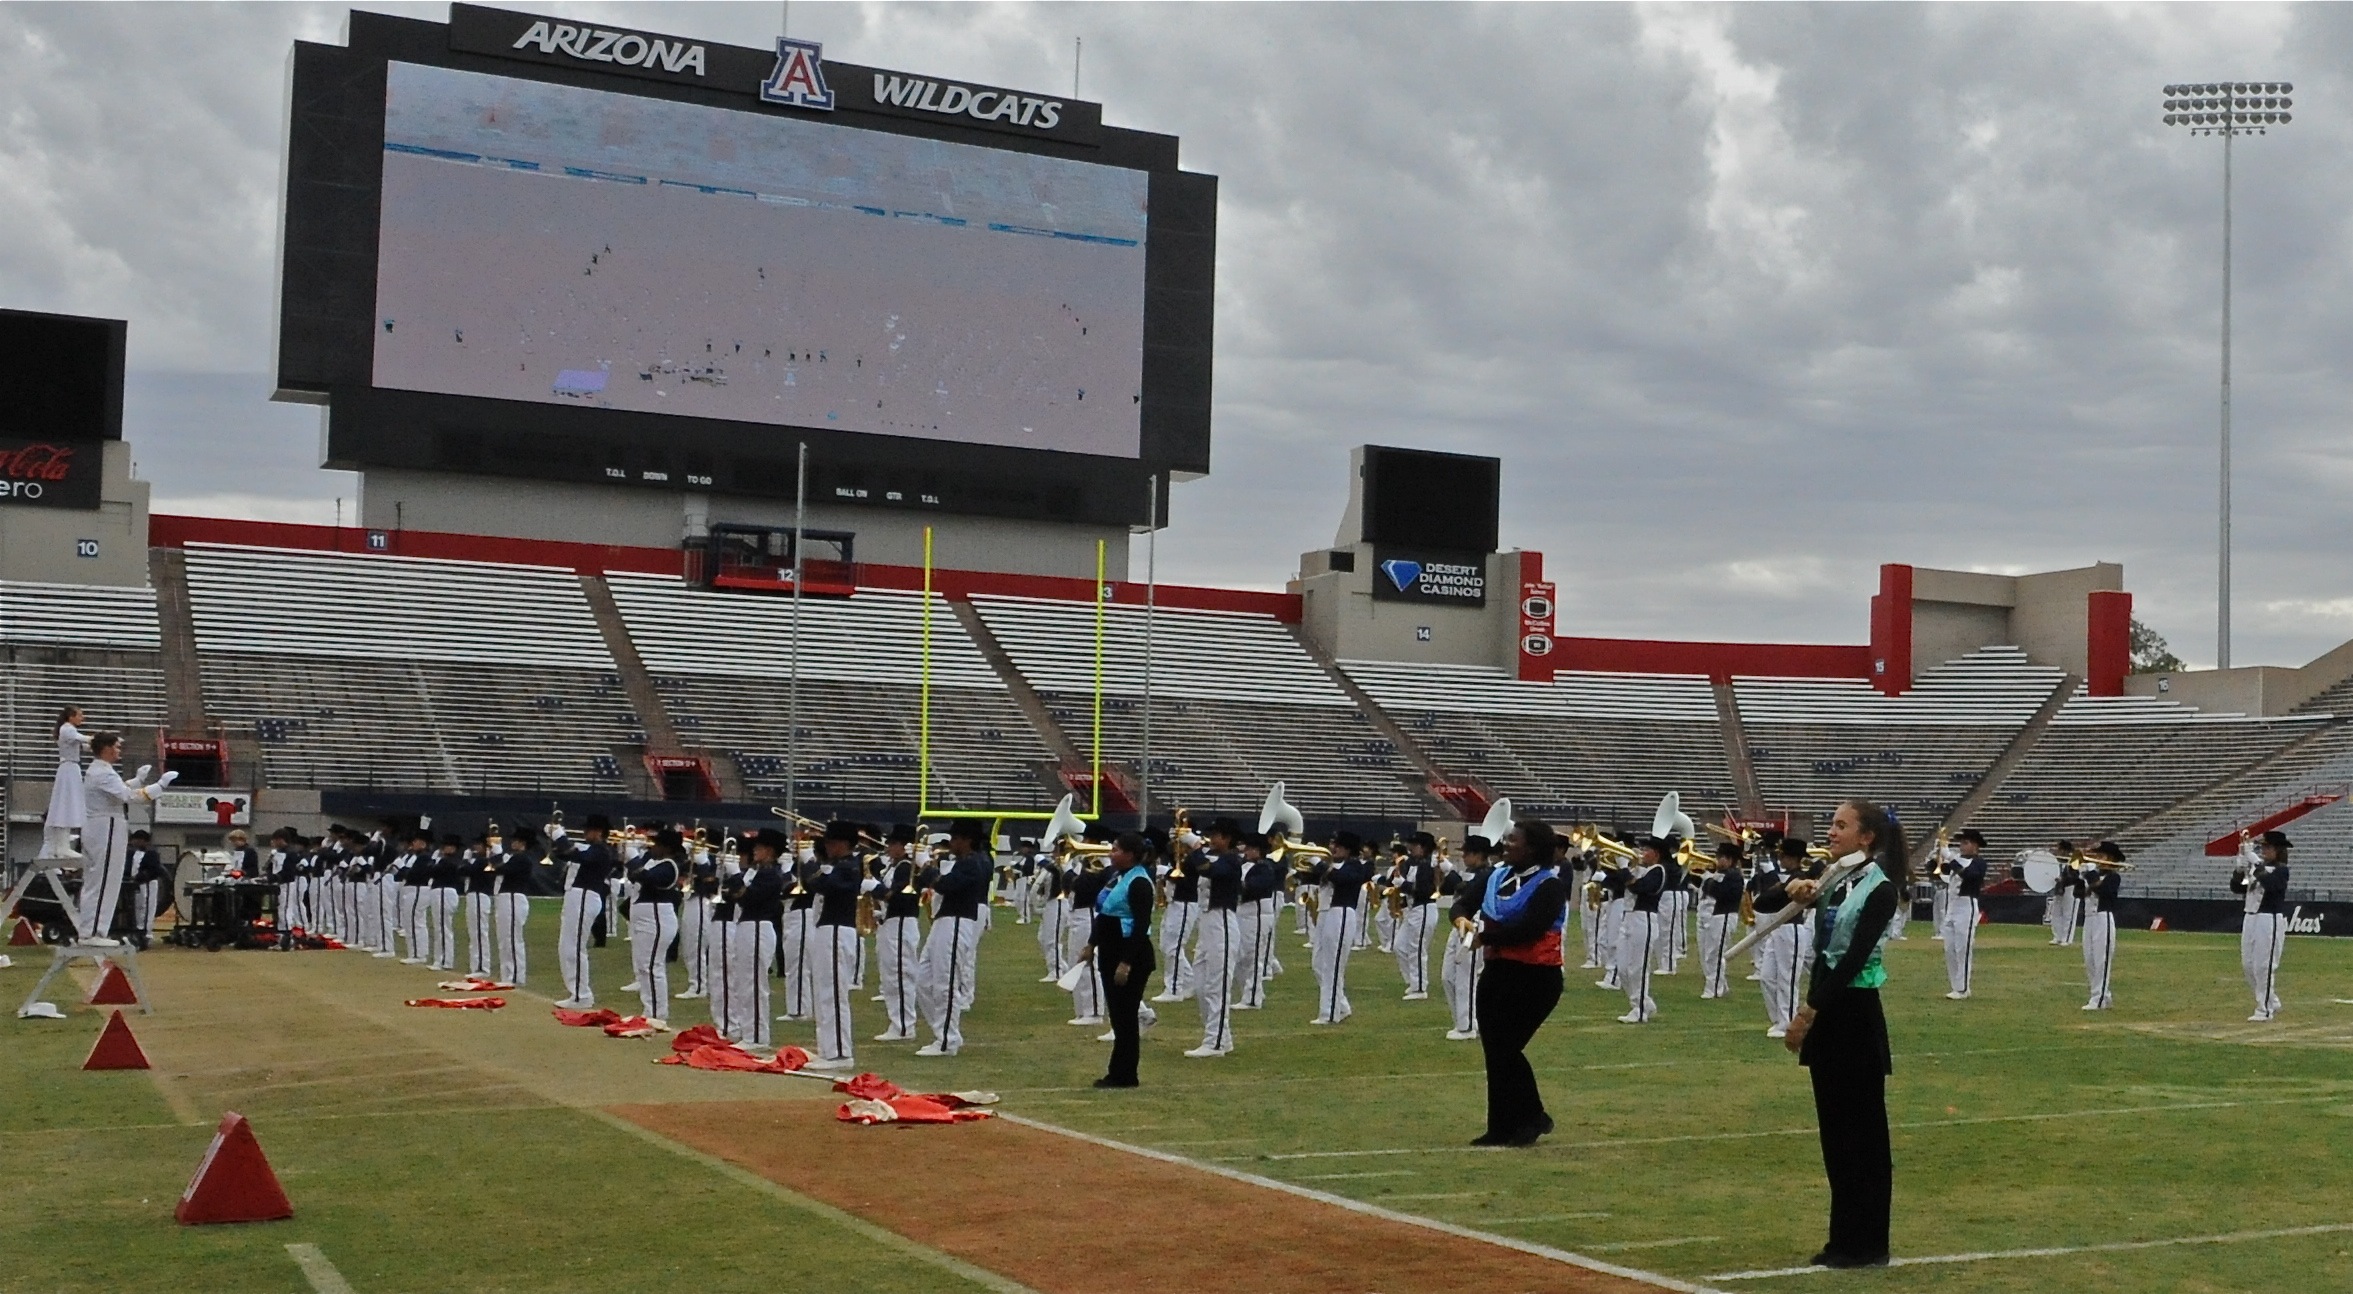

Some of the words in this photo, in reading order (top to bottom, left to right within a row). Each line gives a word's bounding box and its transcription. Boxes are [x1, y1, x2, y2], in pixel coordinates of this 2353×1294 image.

[513, 21, 705, 76] ARIZONA
[760, 36, 834, 111] A
[874, 74, 1063, 129] WILDCATS
[687, 475, 699, 484] TO
[700, 476, 713, 485] GO
[836, 487, 855, 497] BALL
[371, 534, 385, 547] 11
[78, 541, 98, 556] 10
[778, 568, 794, 582] 12
[1425, 563, 1478, 576] DESERT
[1419, 574, 1484, 587] DIAMOND
[1420, 585, 1481, 598] CASINOS
[1417, 628, 1430, 640] 14
